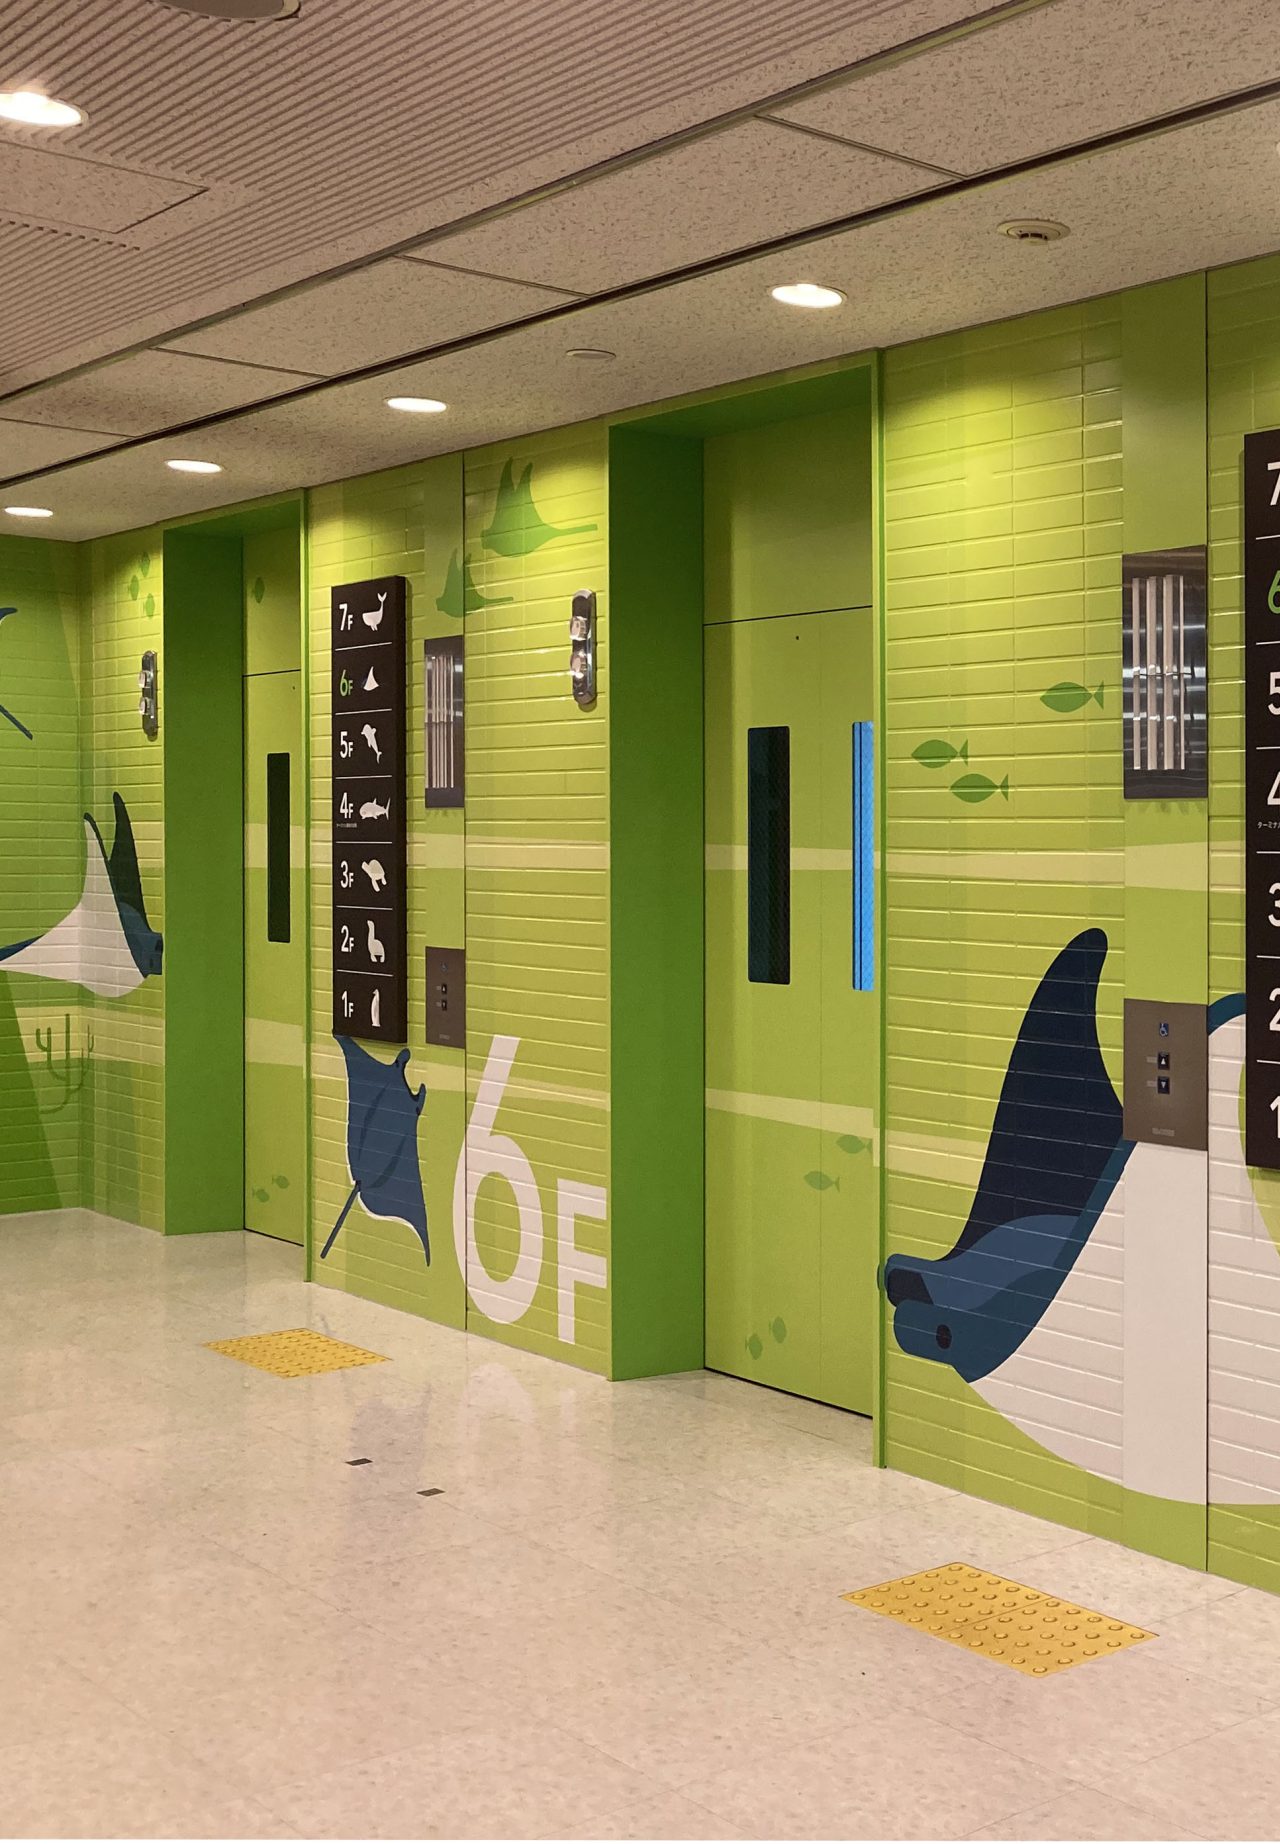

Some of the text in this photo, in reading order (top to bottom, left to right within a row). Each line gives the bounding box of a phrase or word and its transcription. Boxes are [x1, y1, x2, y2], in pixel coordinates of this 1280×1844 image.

[339, 603, 353, 632] 7F
[339, 669, 353, 697] 6F
[339, 730, 353, 759] 5F
[339, 792, 354, 819] 4F
[340, 860, 354, 889] 3F
[340, 924, 354, 953] 2F
[341, 990, 354, 1018] 1F
[452, 1034, 608, 1345] 6F
